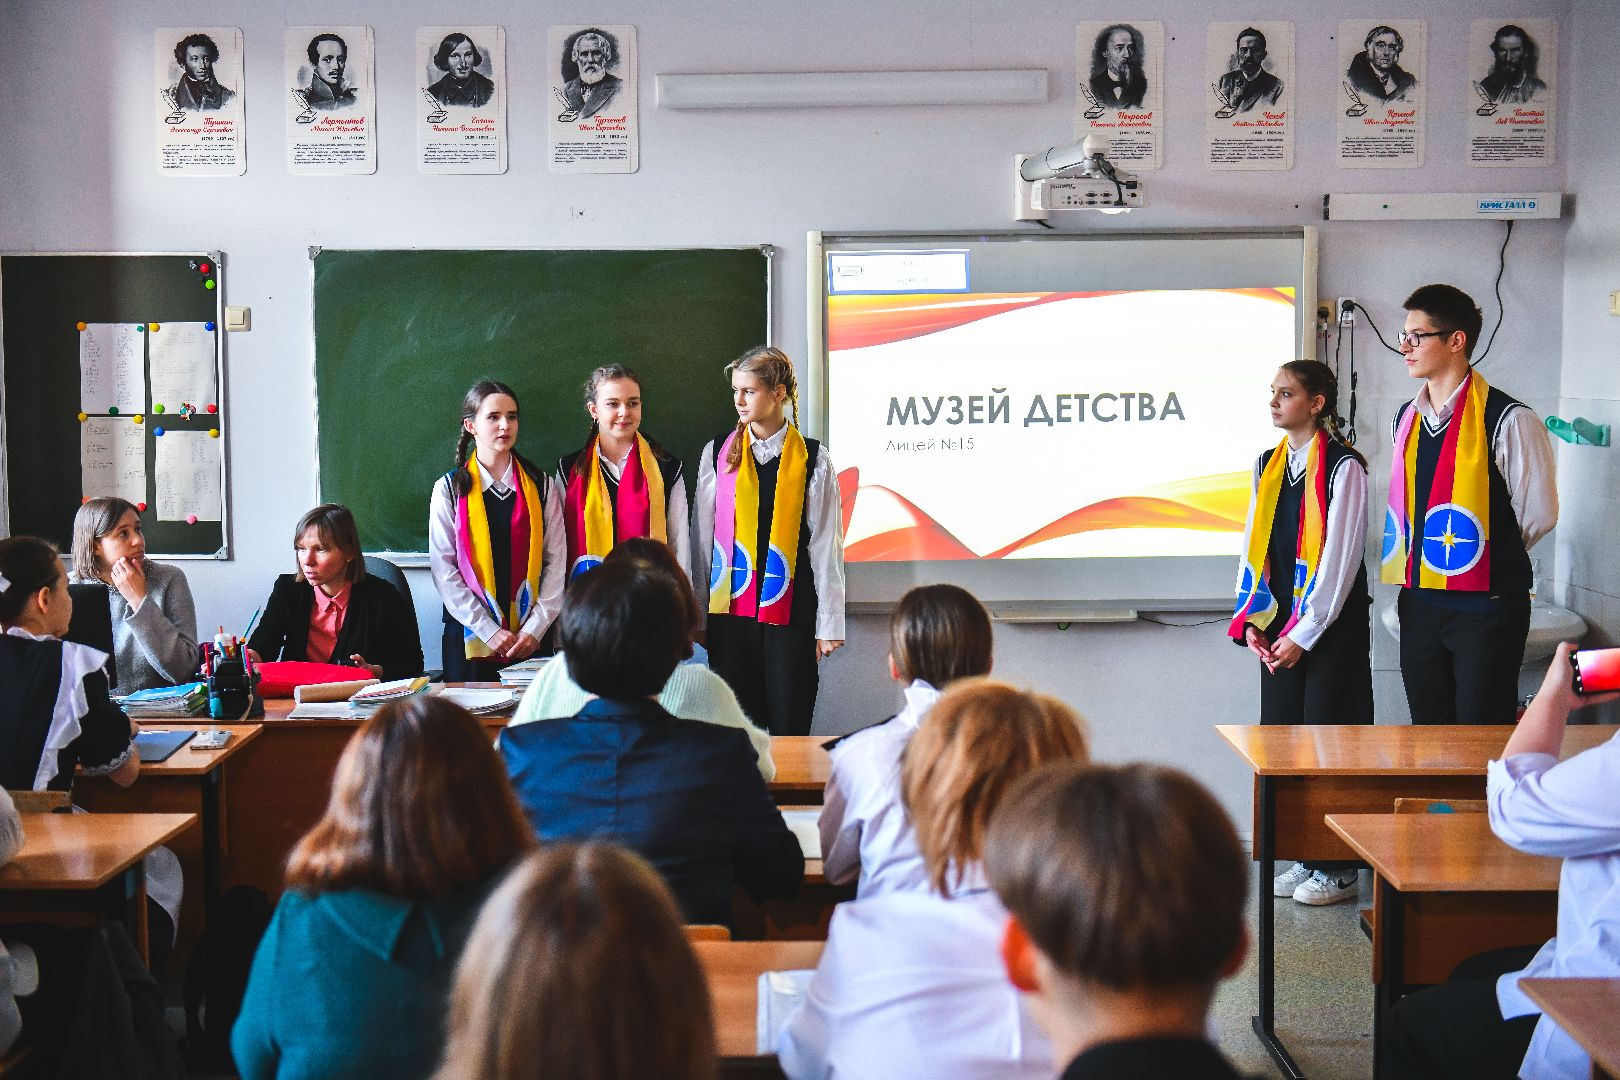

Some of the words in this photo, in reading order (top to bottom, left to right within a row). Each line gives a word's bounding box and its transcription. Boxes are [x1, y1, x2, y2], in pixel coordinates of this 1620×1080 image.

[593, 115, 627, 125] Тургенев
[1117, 111, 1153, 122] Некрасов
[1262, 111, 1286, 120] Чехов
[886, 387, 1009, 425] МУЗЕЙ
[1024, 392, 1185, 427] ДЕТСТВА
[886, 438, 935, 452] Лицей
[941, 437, 974, 450] №15
